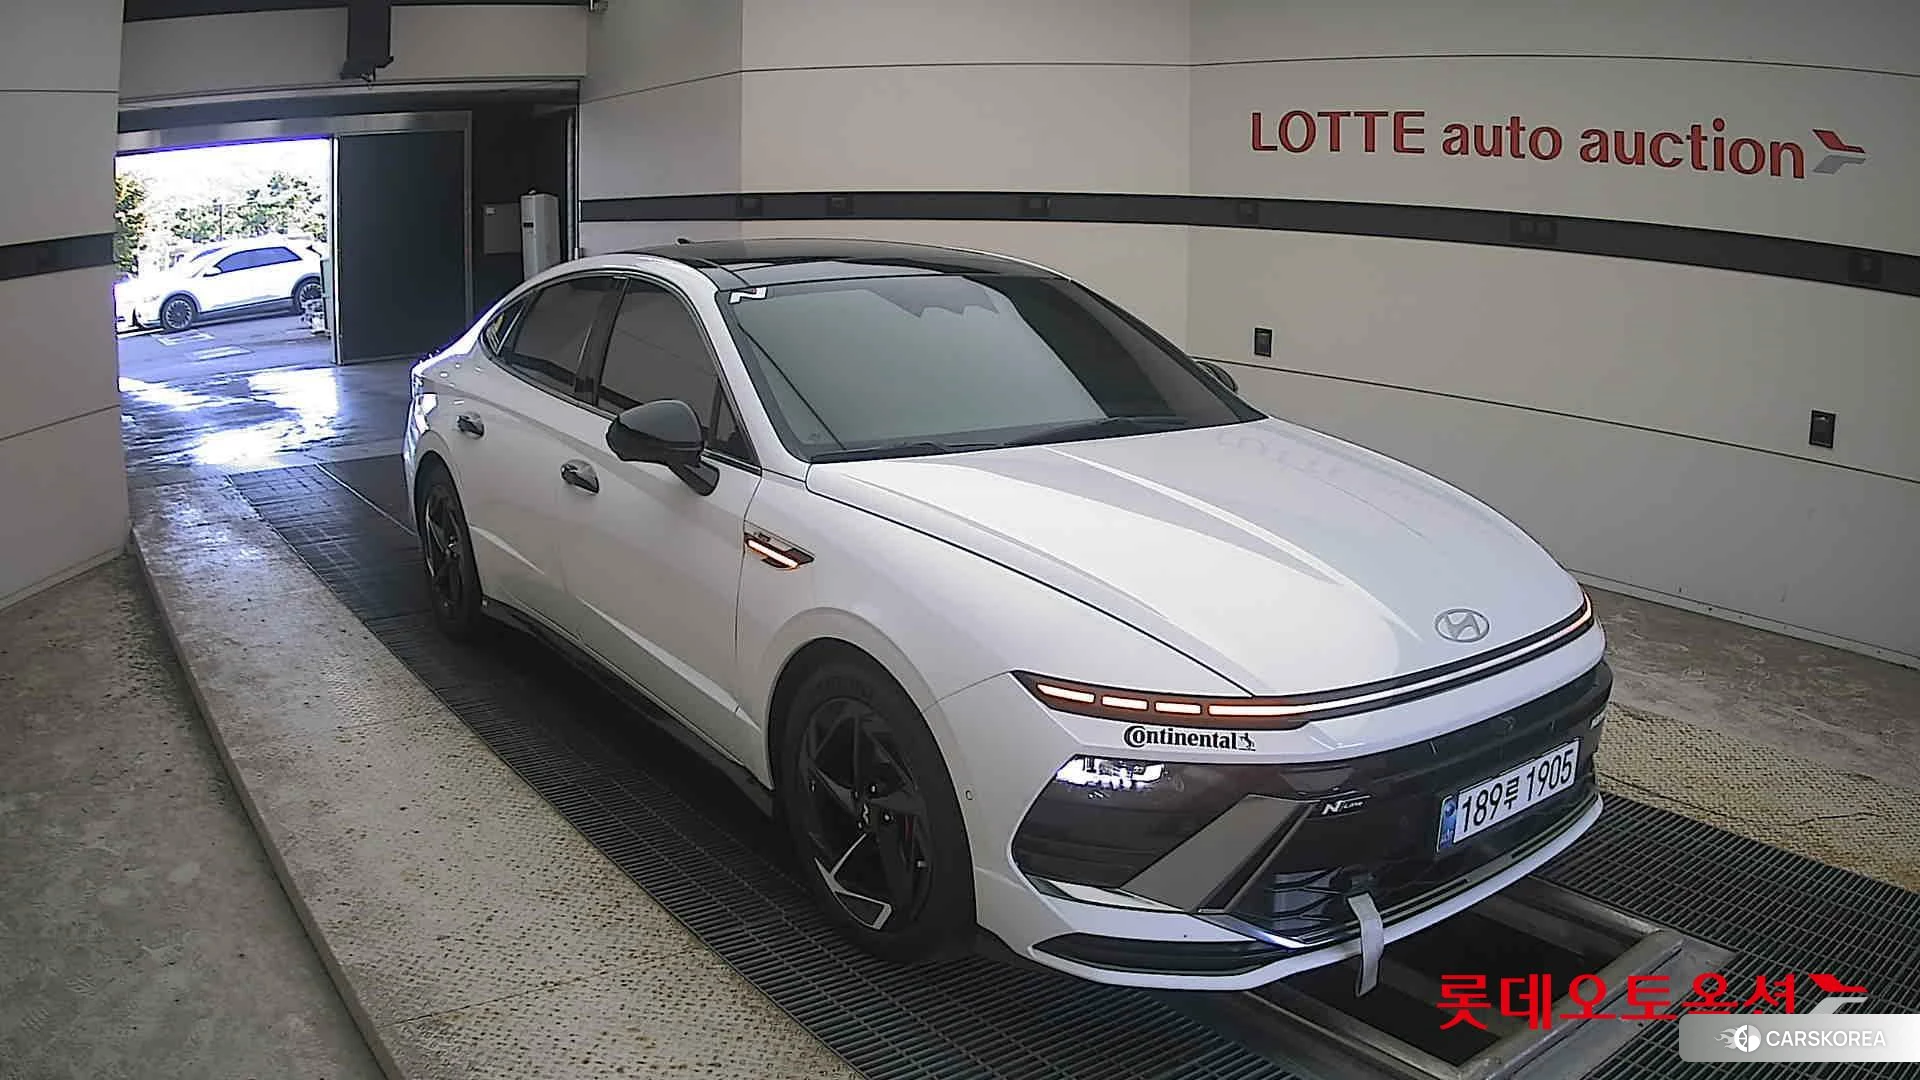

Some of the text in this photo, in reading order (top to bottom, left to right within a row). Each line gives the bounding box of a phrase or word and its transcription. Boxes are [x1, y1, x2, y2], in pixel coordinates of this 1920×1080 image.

[1251, 110, 1806, 180] LOTTE auto auction
[1124, 725, 1237, 750] Continental
[1461, 748, 1574, 833] 189루 1905
